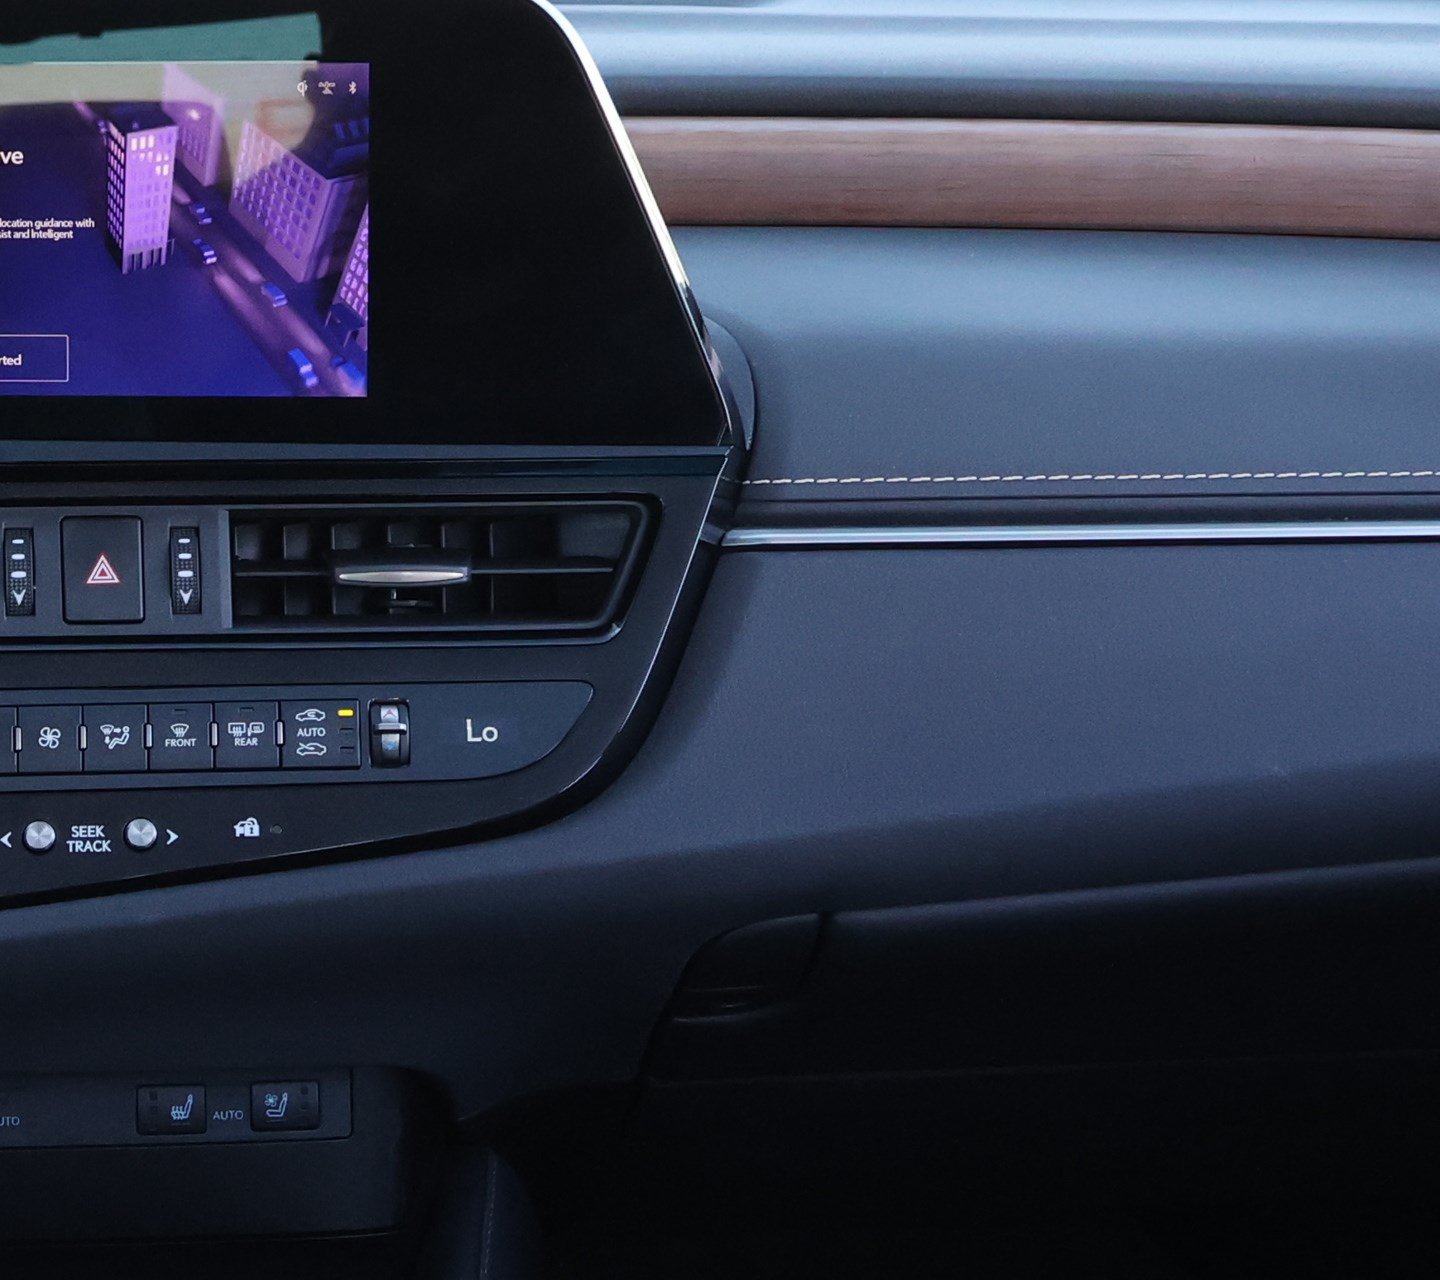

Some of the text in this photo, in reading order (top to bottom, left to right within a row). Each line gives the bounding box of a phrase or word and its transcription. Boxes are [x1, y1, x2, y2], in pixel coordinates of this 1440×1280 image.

[0, 218, 33, 229] location
[34, 218, 73, 230] guidance
[75, 218, 95, 229] with
[13, 229, 29, 240] and
[31, 229, 73, 240] Intelligent
[296, 727, 326, 739] AUTO
[465, 718, 499, 742] Lo
[165, 738, 197, 749] FRONT
[233, 736, 259, 747] REAR
[70, 825, 106, 839] SEEK
[66, 838, 112, 854] TRACK
[212, 1110, 244, 1121] AUTO
